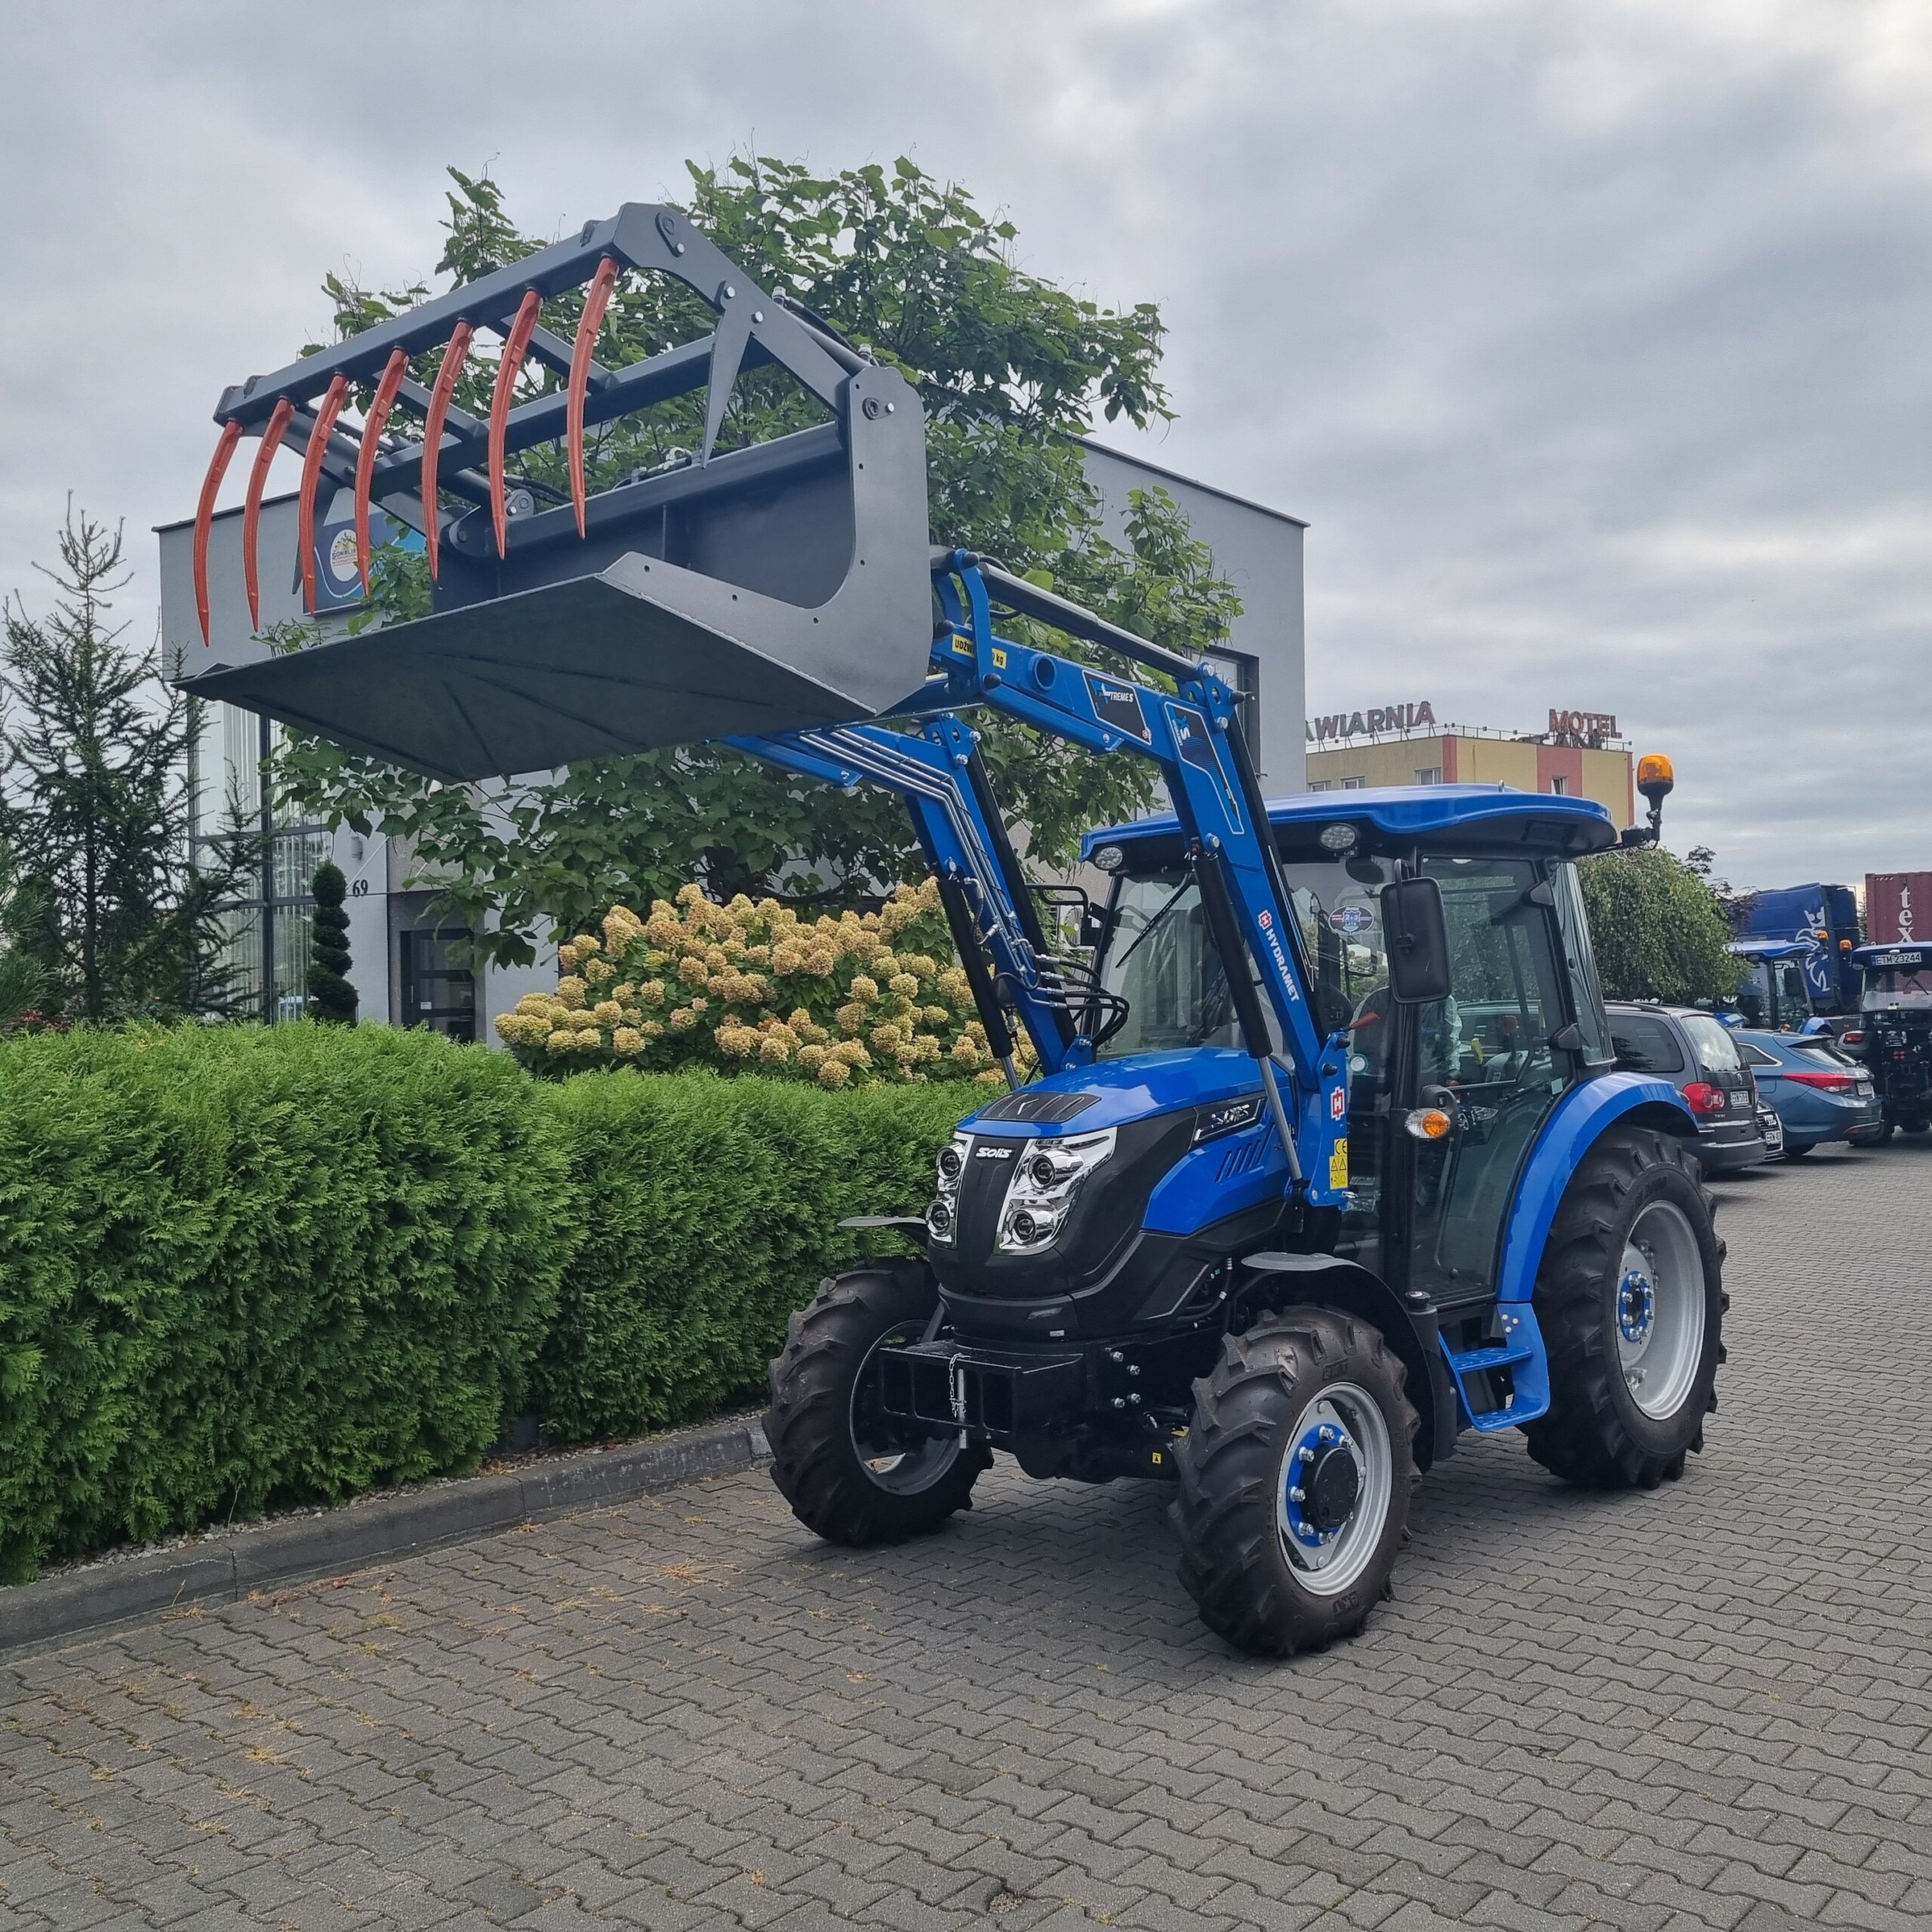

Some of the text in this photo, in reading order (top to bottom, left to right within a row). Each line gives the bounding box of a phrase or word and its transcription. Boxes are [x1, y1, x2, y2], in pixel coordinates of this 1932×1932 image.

[996, 654, 1004, 666] kg
[1549, 708, 1623, 739] MOTEL
[352, 878, 368, 898] 69
[1266, 928, 1300, 1001] HYDRAMET
[1876, 953, 1921, 965] ETM 23244
[1335, 1140, 1347, 1155] CE
